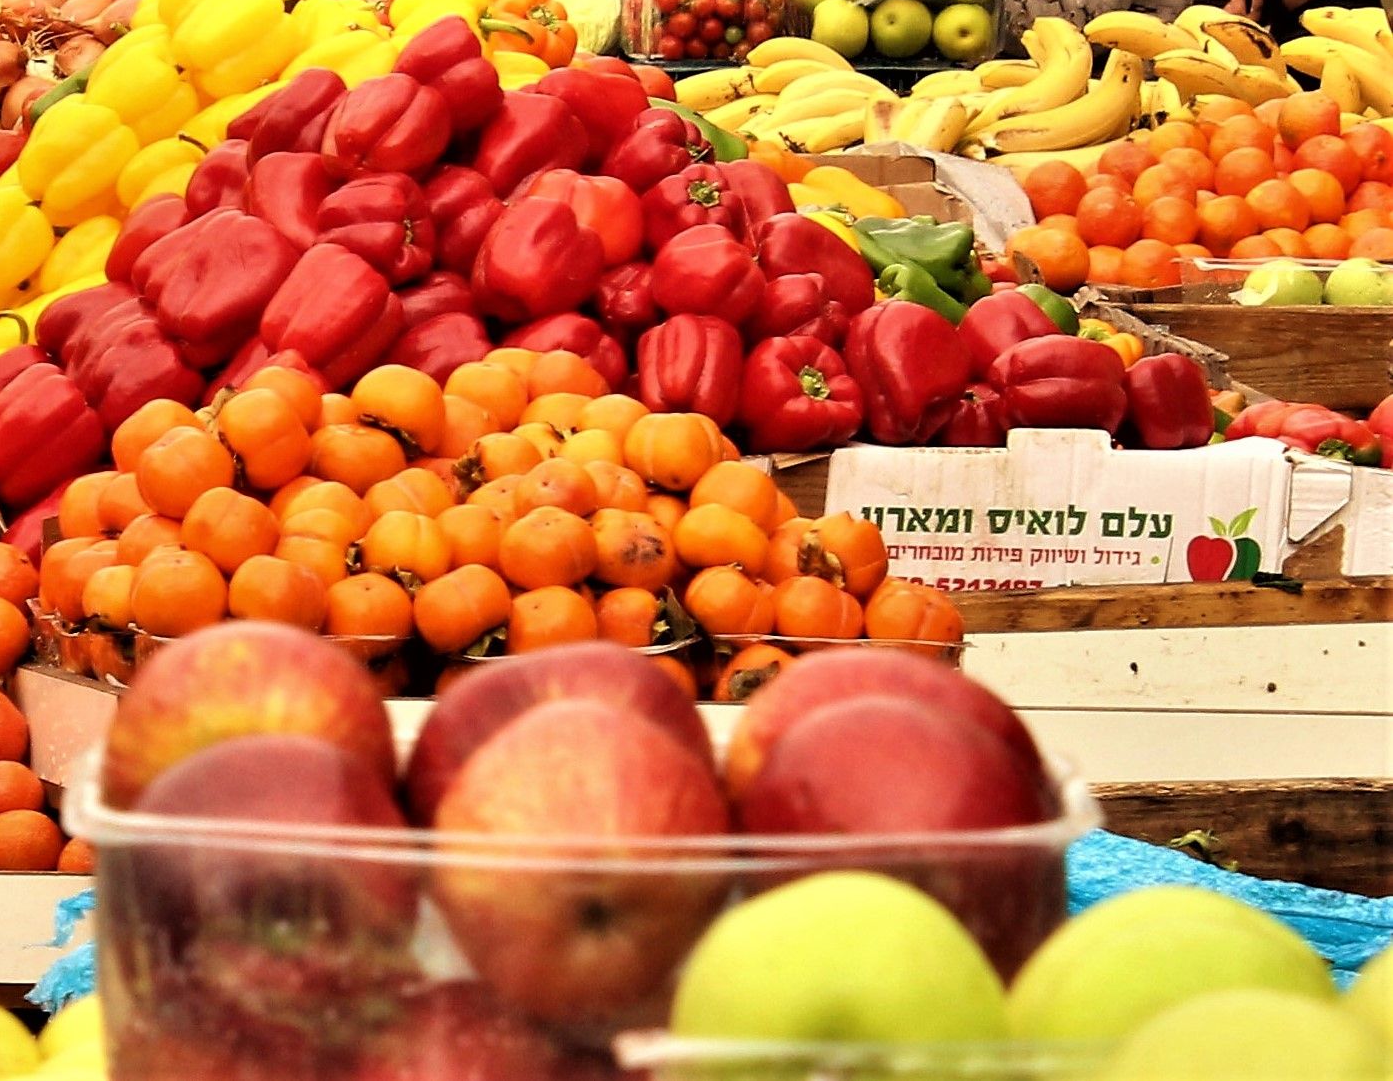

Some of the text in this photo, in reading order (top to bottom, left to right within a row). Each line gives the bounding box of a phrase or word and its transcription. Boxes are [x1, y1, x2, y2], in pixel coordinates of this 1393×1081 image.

[986, 504, 1088, 535] לואיס
[1100, 506, 1174, 539] עלם
[886, 544, 1141, 567] גידול ושיווק פירות מובחרים
